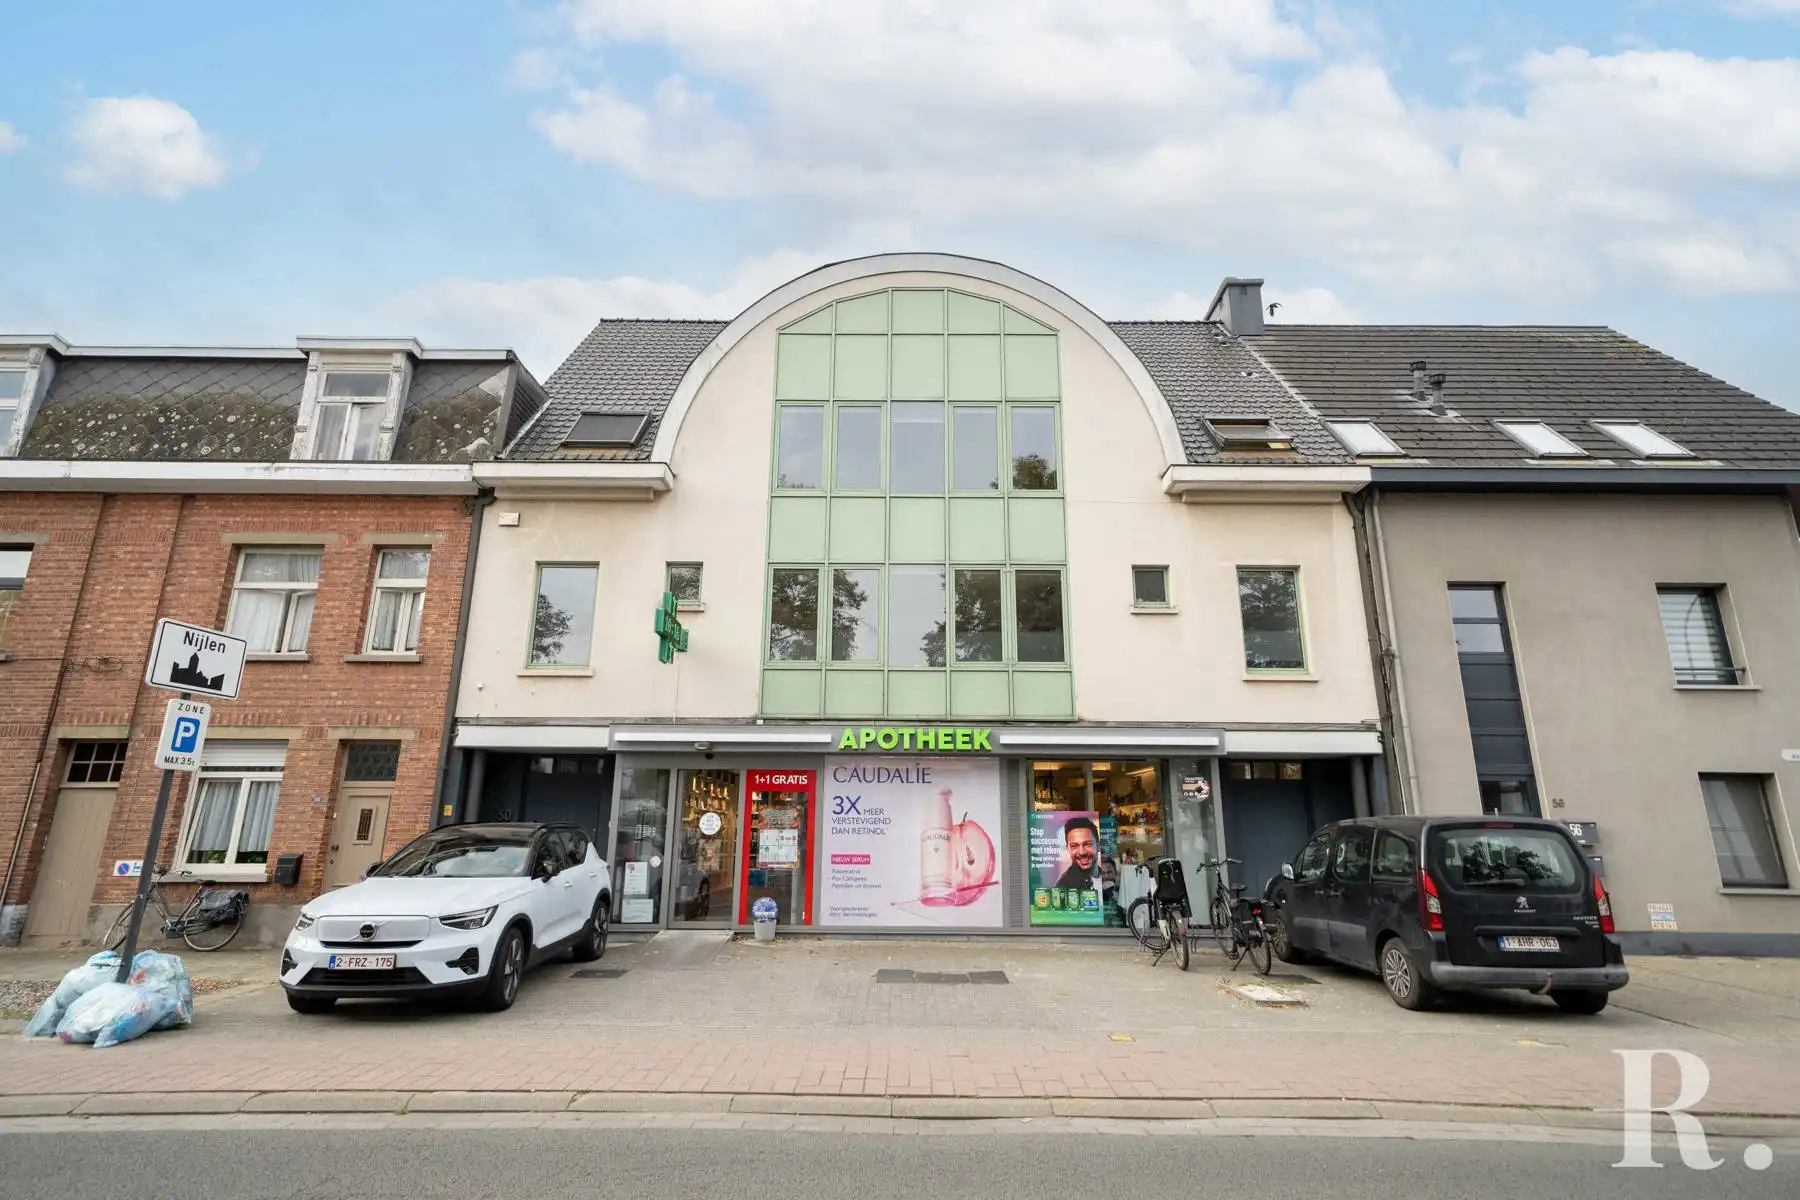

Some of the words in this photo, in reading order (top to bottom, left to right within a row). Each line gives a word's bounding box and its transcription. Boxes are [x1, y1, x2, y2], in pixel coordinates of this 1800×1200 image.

[183, 630, 227, 654] Nijlen
[177, 702, 206, 715] ZONE
[174, 720, 197, 749] P
[838, 727, 993, 752] APOTHEEK
[163, 755, 179, 765] MAX
[754, 774, 771, 785] 1+1
[771, 774, 808, 785] GRATIS
[831, 795, 862, 816] 3X
[863, 807, 885, 816] MEER
[831, 816, 892, 825] VERSTEVIGEND
[831, 826, 850, 836] DAN
[1030, 827, 1044, 837] Stop
[1568, 823, 1583, 837] 56
